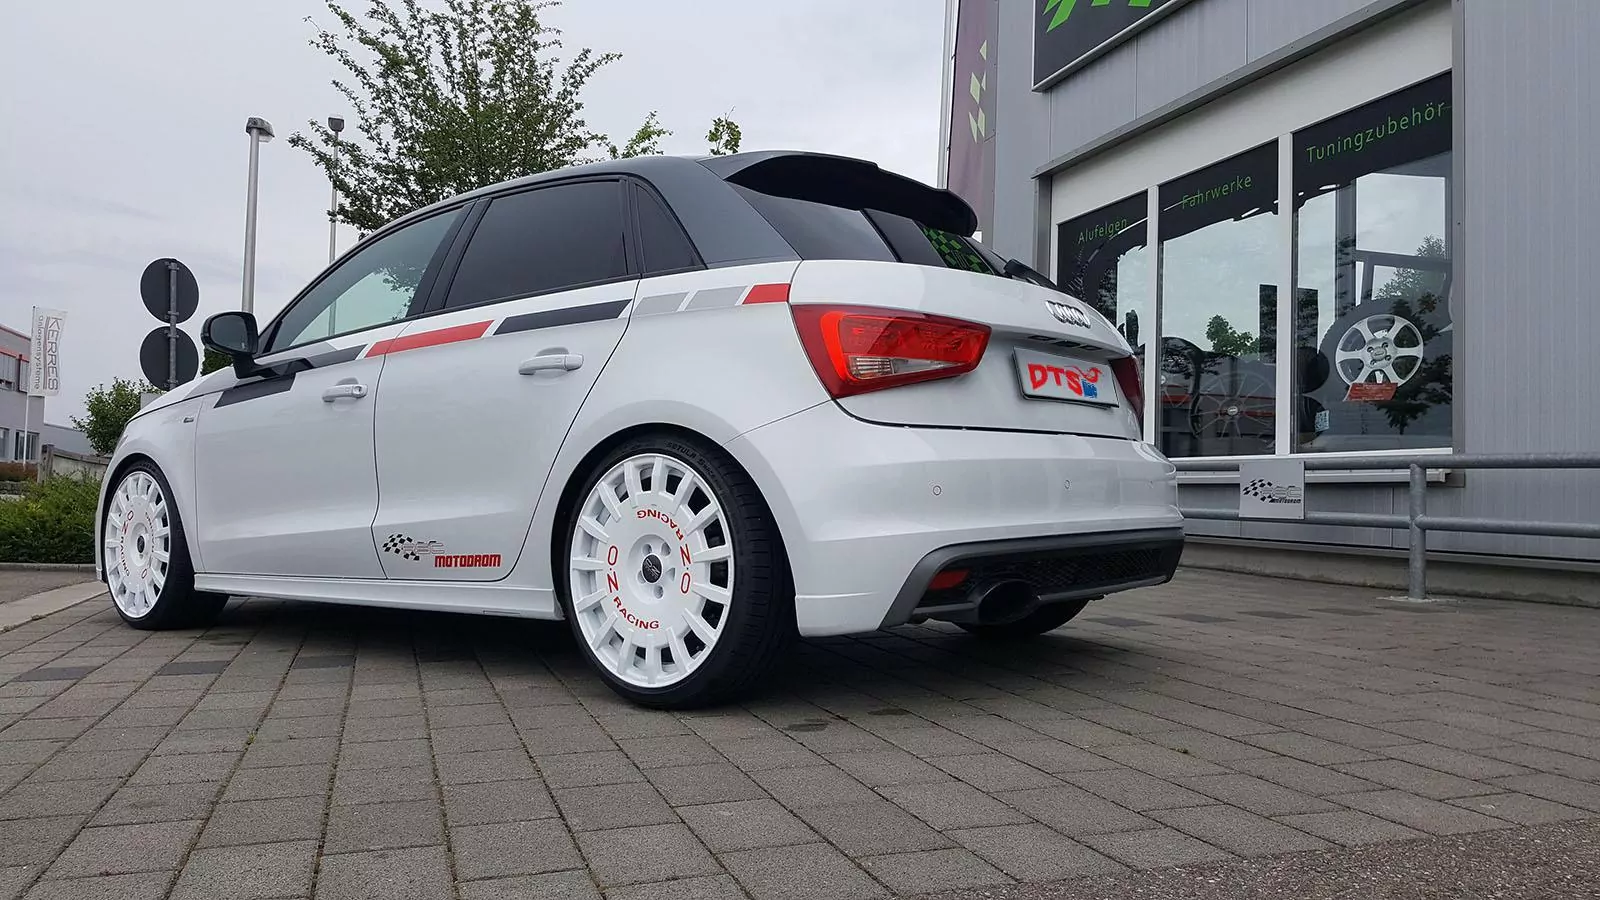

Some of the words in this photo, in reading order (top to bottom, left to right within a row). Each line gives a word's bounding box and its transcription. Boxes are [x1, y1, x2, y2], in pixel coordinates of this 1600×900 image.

[1307, 102, 1446, 163] Tuningzubehör
[1182, 175, 1253, 209] Fahrwerke
[1078, 218, 1128, 244] Alufelgen
[47, 316, 63, 391] KERRES
[1027, 363, 1083, 397] DTS
[636, 508, 685, 541] RACING
[434, 554, 501, 568] MOTODROM
[613, 595, 660, 630] RACING
